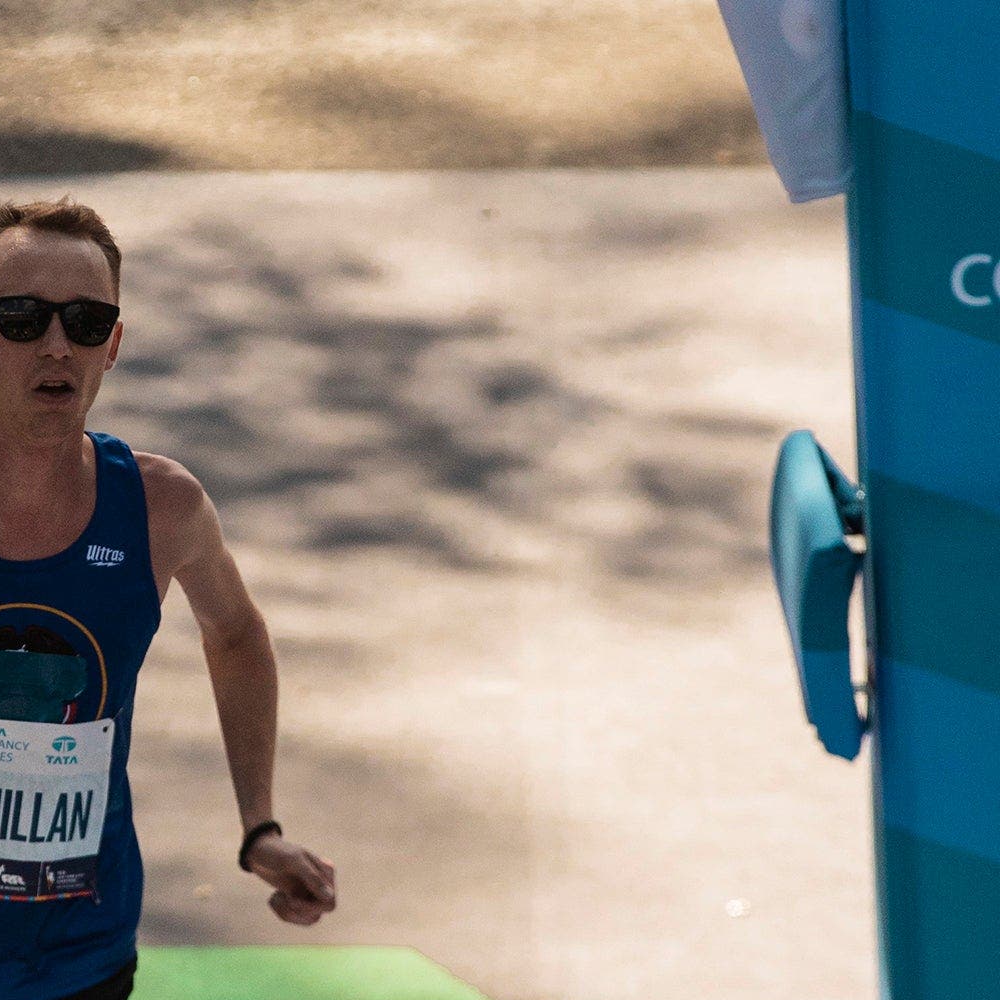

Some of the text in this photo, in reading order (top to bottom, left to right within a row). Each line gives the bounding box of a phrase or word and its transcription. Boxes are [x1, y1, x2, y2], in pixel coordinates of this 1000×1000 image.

[951, 253, 1000, 307] C
[86, 544, 125, 562] Ultras
[45, 755, 79, 765] TATA
